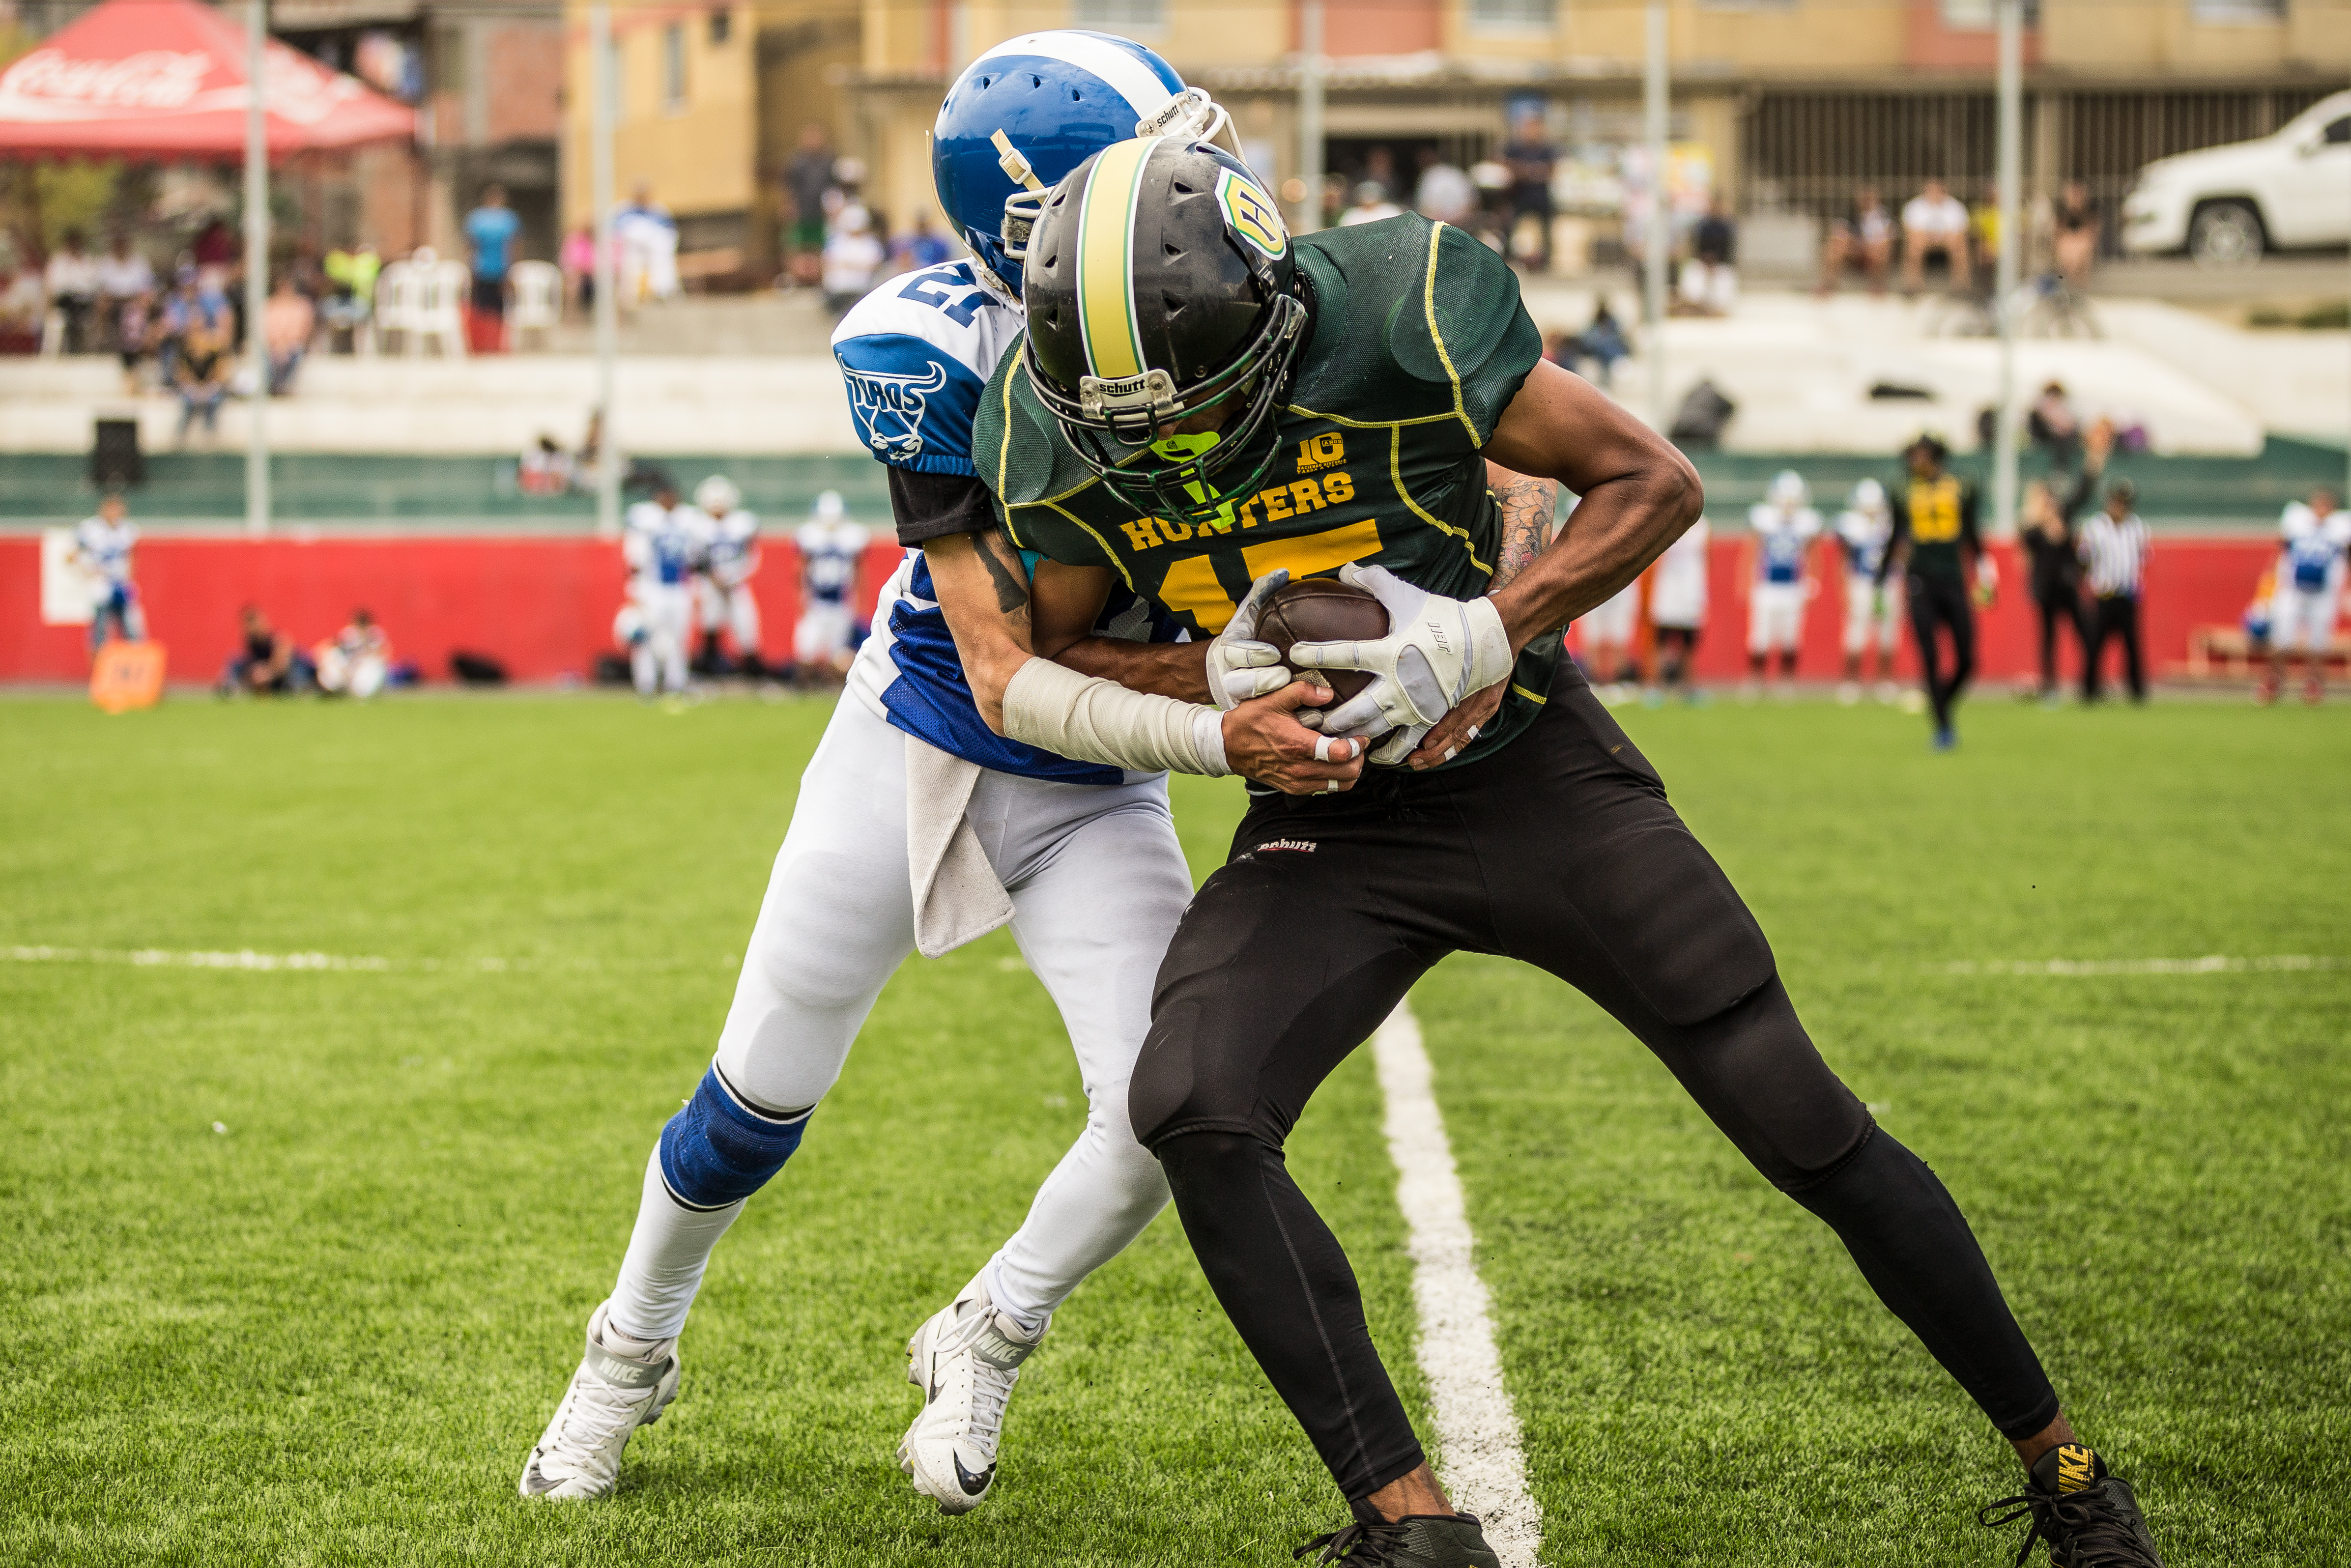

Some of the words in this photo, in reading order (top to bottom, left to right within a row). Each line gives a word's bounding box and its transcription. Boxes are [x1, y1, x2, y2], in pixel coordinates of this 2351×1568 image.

[1157, 104, 1179, 127] schutt
[1099, 379, 1145, 393] schutt
[1297, 432, 1344, 466] 10
[975, 1332, 1024, 1363] NIKE
[598, 1356, 644, 1383] NIKE
